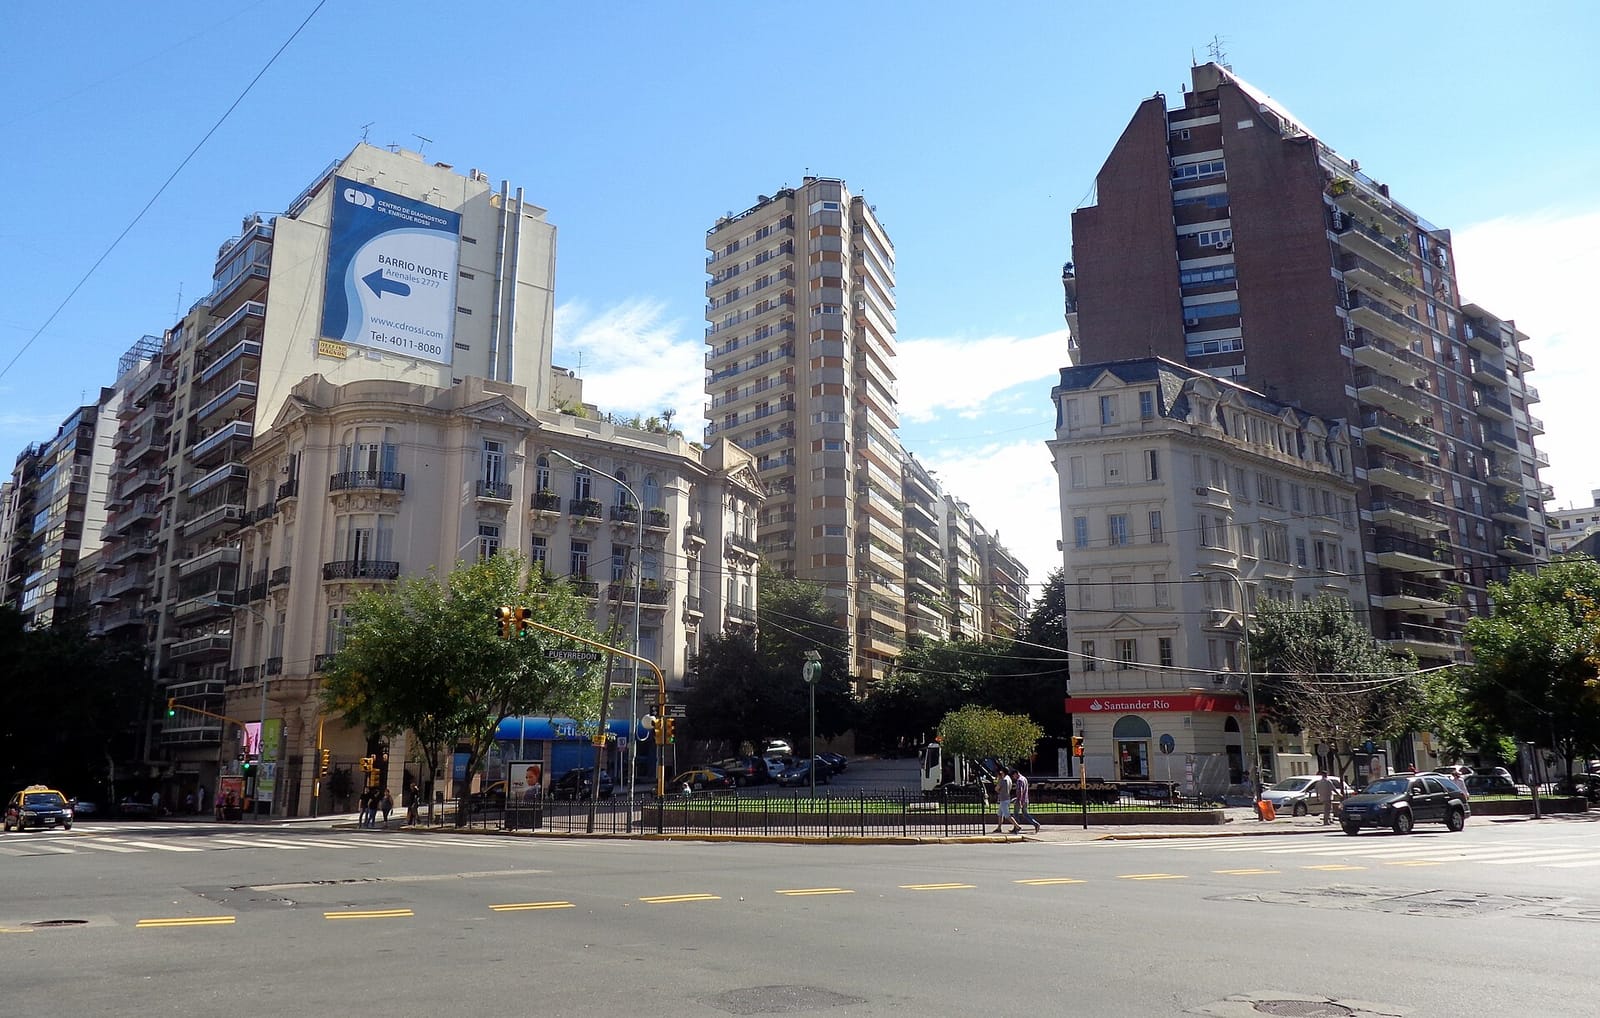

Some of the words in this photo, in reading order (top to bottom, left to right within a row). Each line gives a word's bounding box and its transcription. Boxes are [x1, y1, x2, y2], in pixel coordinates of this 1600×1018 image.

[378, 200, 401, 212] CENTRO
[388, 210, 413, 221] ENRIQUE
[413, 216, 431, 226] ROSSI
[378, 254, 415, 272] BARRIO
[417, 265, 449, 281] NORTE
[385, 269, 420, 285] Arenales
[420, 278, 440, 289] 2777
[370, 315, 444, 339] www.cdrossi.com
[370, 330, 388, 344] Tel:
[389, 336, 442, 356] 4011-8080
[1104, 699, 1151, 711] Santander
[1153, 699, 1170, 709] Río
